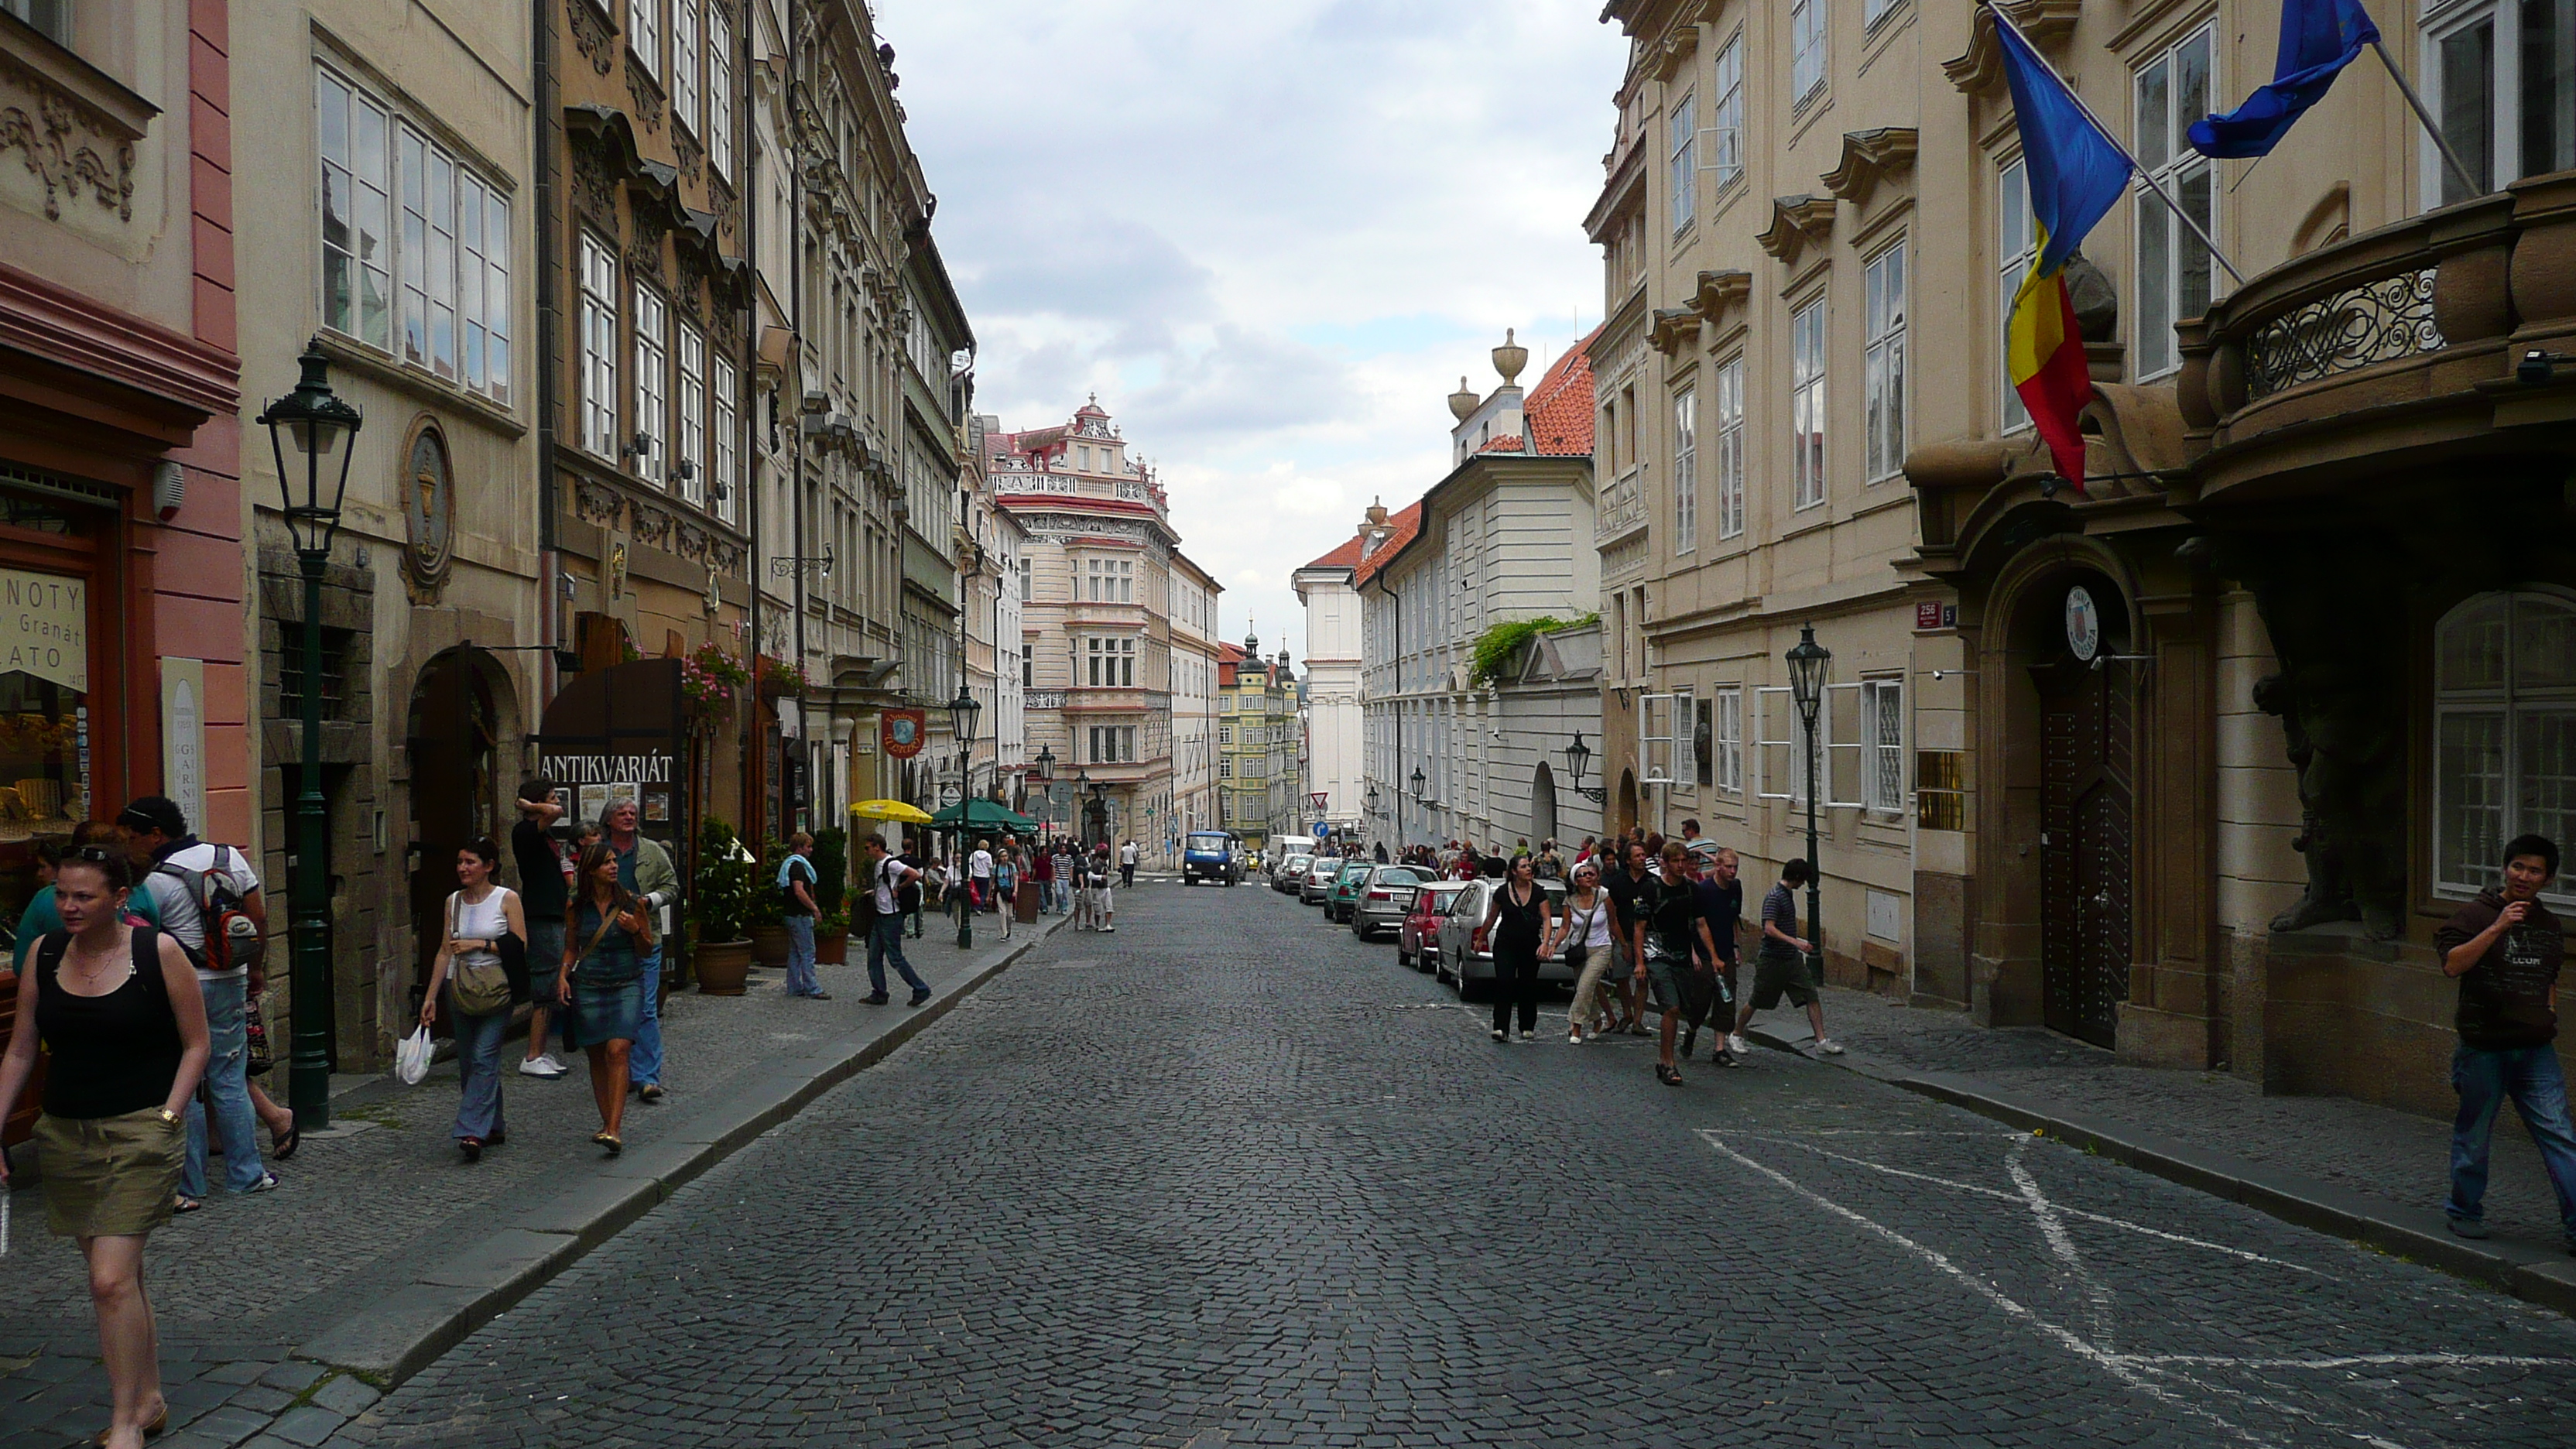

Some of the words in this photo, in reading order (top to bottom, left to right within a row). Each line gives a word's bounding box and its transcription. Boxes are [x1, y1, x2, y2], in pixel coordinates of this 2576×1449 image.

[6, 578, 79, 611] NOTY
[1920, 605, 1936, 615] 256
[1945, 610, 1951, 621] 5
[19, 614, 80, 646] Granát
[0, 646, 60, 668] ATO
[541, 748, 673, 783] ANTIKVARIÁT
